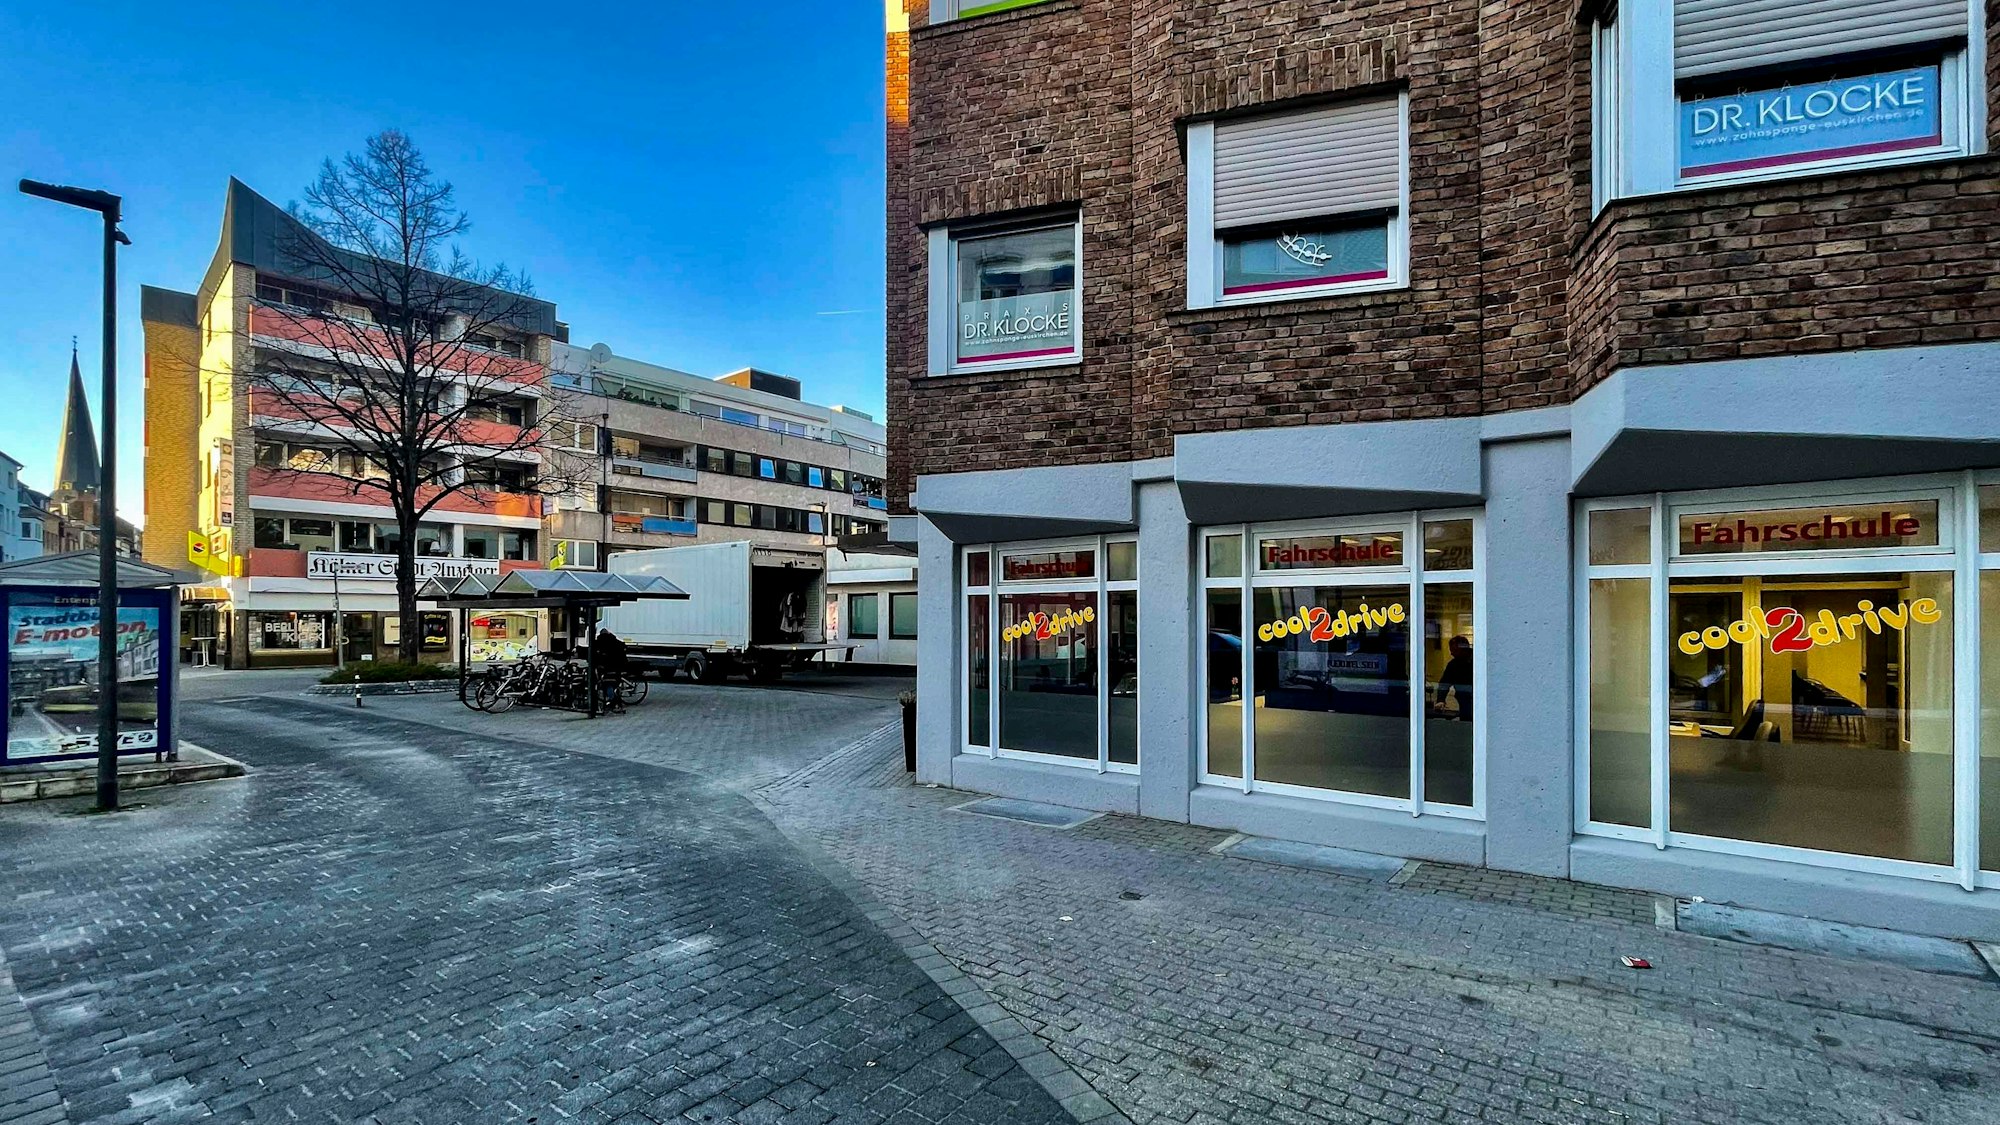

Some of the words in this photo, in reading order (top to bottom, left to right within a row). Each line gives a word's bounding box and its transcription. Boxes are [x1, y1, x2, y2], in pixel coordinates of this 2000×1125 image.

[1694, 104, 1750, 135] DR.
[1759, 76, 1924, 125] KLOCKE
[1695, 108, 1924, 147] www.zahnspange-euskirchen.de
[964, 302, 1068, 320] PRAXIS
[964, 322, 991, 339] DR.
[994, 312, 1069, 336] KLOCKE
[964, 330, 1069, 346] www.zahnspange-euskirchen.de
[1694, 511, 1920, 545] Fahrschule
[1268, 539, 1394, 563] Fahrschule
[310, 557, 374, 575] Kölner
[378, 559, 498, 578] Stdt-Anzeiger
[1010, 555, 1089, 575] Fahrschule
[14, 620, 146, 645] E-moton
[1002, 606, 1095, 642] cool2drive
[1258, 603, 1405, 644] cool2drive
[1678, 597, 1941, 655] cool2drive
